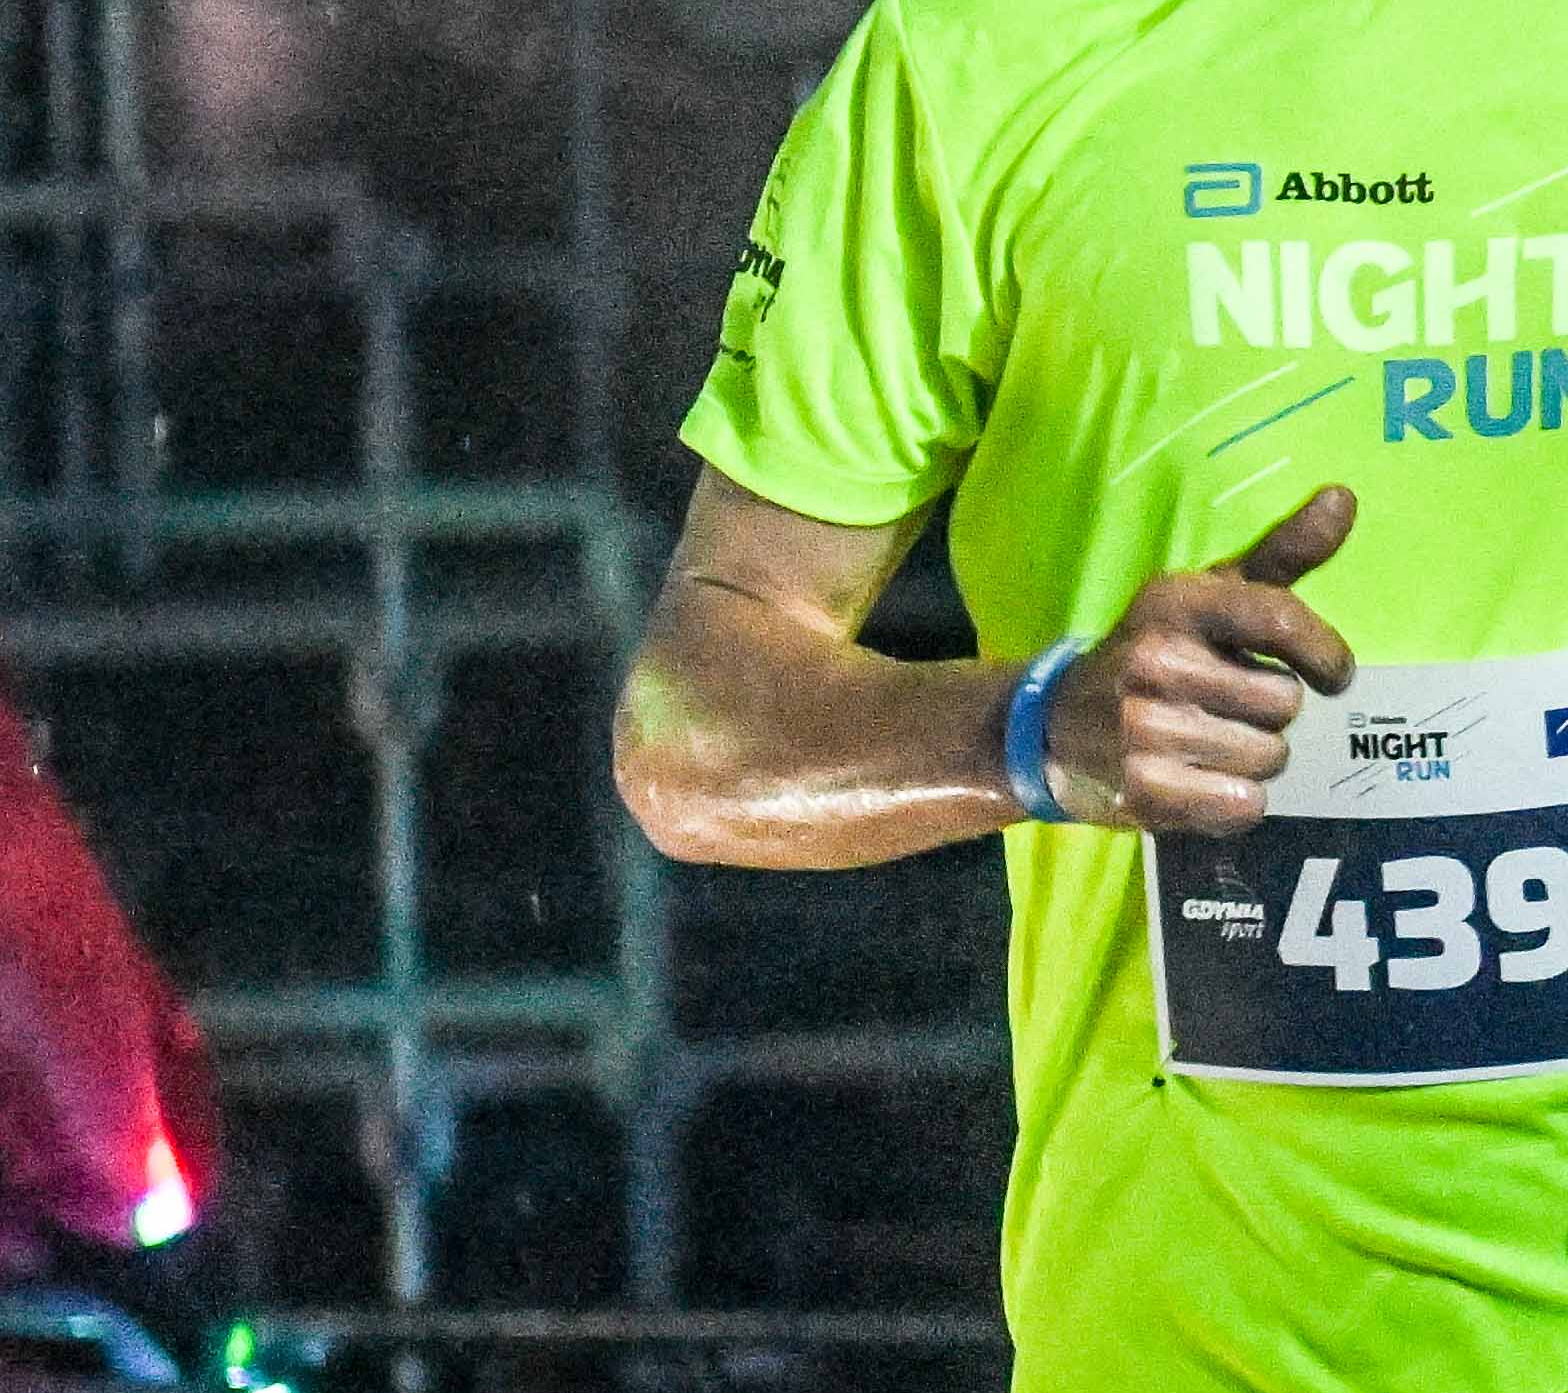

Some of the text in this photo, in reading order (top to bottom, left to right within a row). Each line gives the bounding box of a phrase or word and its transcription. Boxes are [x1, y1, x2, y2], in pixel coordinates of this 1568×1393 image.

[1275, 171, 1434, 206] Abbott
[1349, 731, 1448, 760] NIGHT
[1396, 760, 1450, 782] RUN
